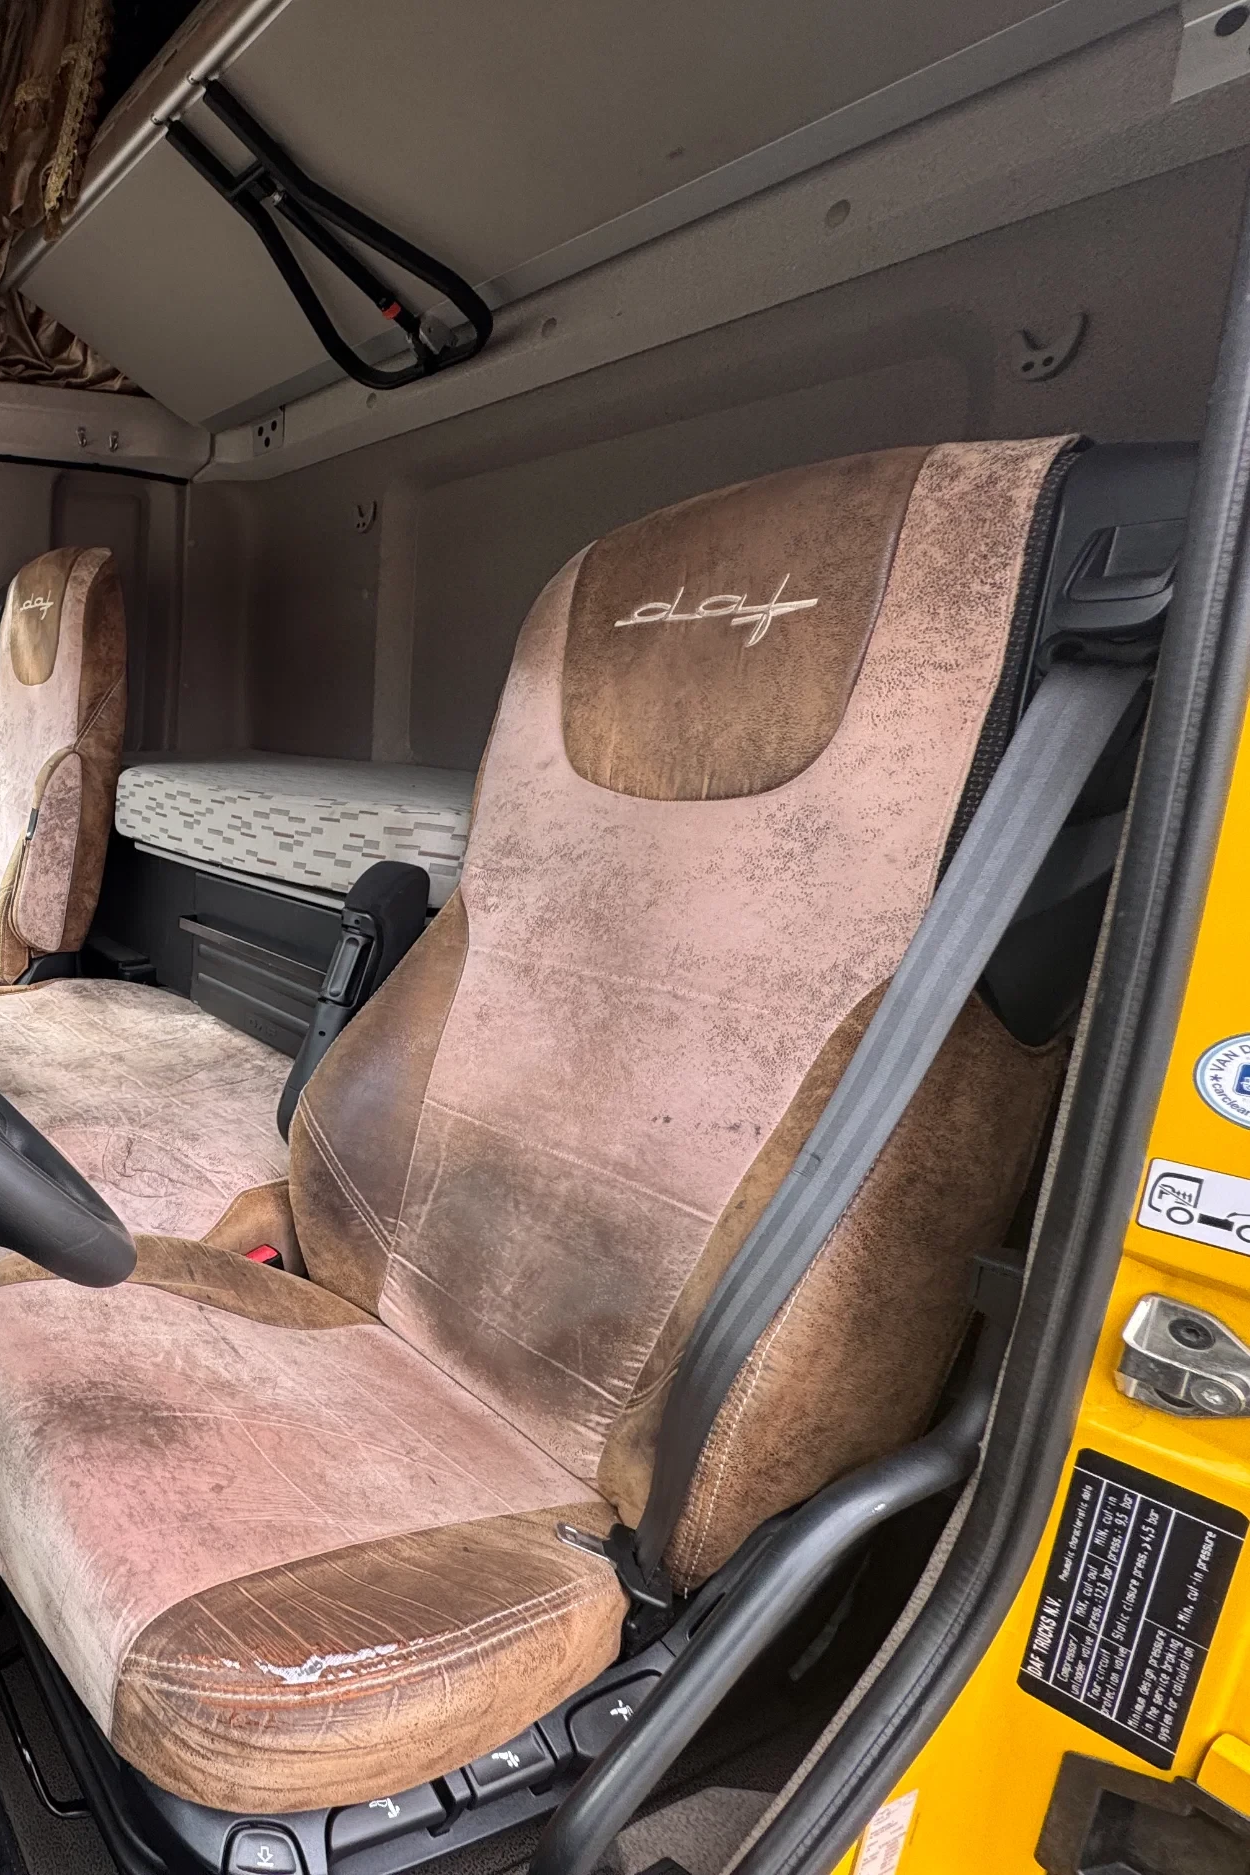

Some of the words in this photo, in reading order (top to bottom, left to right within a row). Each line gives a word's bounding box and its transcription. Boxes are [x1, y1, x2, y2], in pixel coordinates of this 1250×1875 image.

[1210, 1050, 1240, 1073] VAN
[1119, 1493, 1133, 1510] bar
[1114, 1511, 1129, 1527] 9,5
[1058, 1550, 1075, 1582] Pneumatic
[1068, 1501, 1088, 1550] characteristic
[1081, 1484, 1093, 1501] data
[1093, 1528, 1109, 1547] MIN.
[1099, 1564, 1113, 1581] bar
[1111, 1612, 1130, 1641] Static
[1121, 1578, 1140, 1612] closure
[1132, 1551, 1148, 1579] press.
[1144, 1508, 1159, 1525] bar
[1177, 1605, 1194, 1624] Min.
[1196, 1530, 1216, 1572] pressure
[1042, 1595, 1062, 1617] N.V.
[1074, 1600, 1090, 1617] MAX.
[1032, 1615, 1057, 1654] TRUCKS
[1026, 1652, 1045, 1677] DAF
[1070, 1659, 1086, 1695] unloader
[1080, 1635, 1094, 1658] valve
[1160, 1638, 1184, 1672] braking
[1100, 1672, 1119, 1717] protection
[1114, 1645, 1129, 1670] valve
[1126, 1696, 1146, 1729] Minimum
[1137, 1667, 1157, 1696] design
[1148, 1629, 1167, 1668] pressure
[1171, 1646, 1194, 1696] calculation
[1152, 1672, 1170, 1705] service
[1145, 1705, 1160, 1721] the
[1163, 1697, 1178, 1713] for
[1141, 1722, 1154, 1733] in
[1157, 1713, 1173, 1742] system
